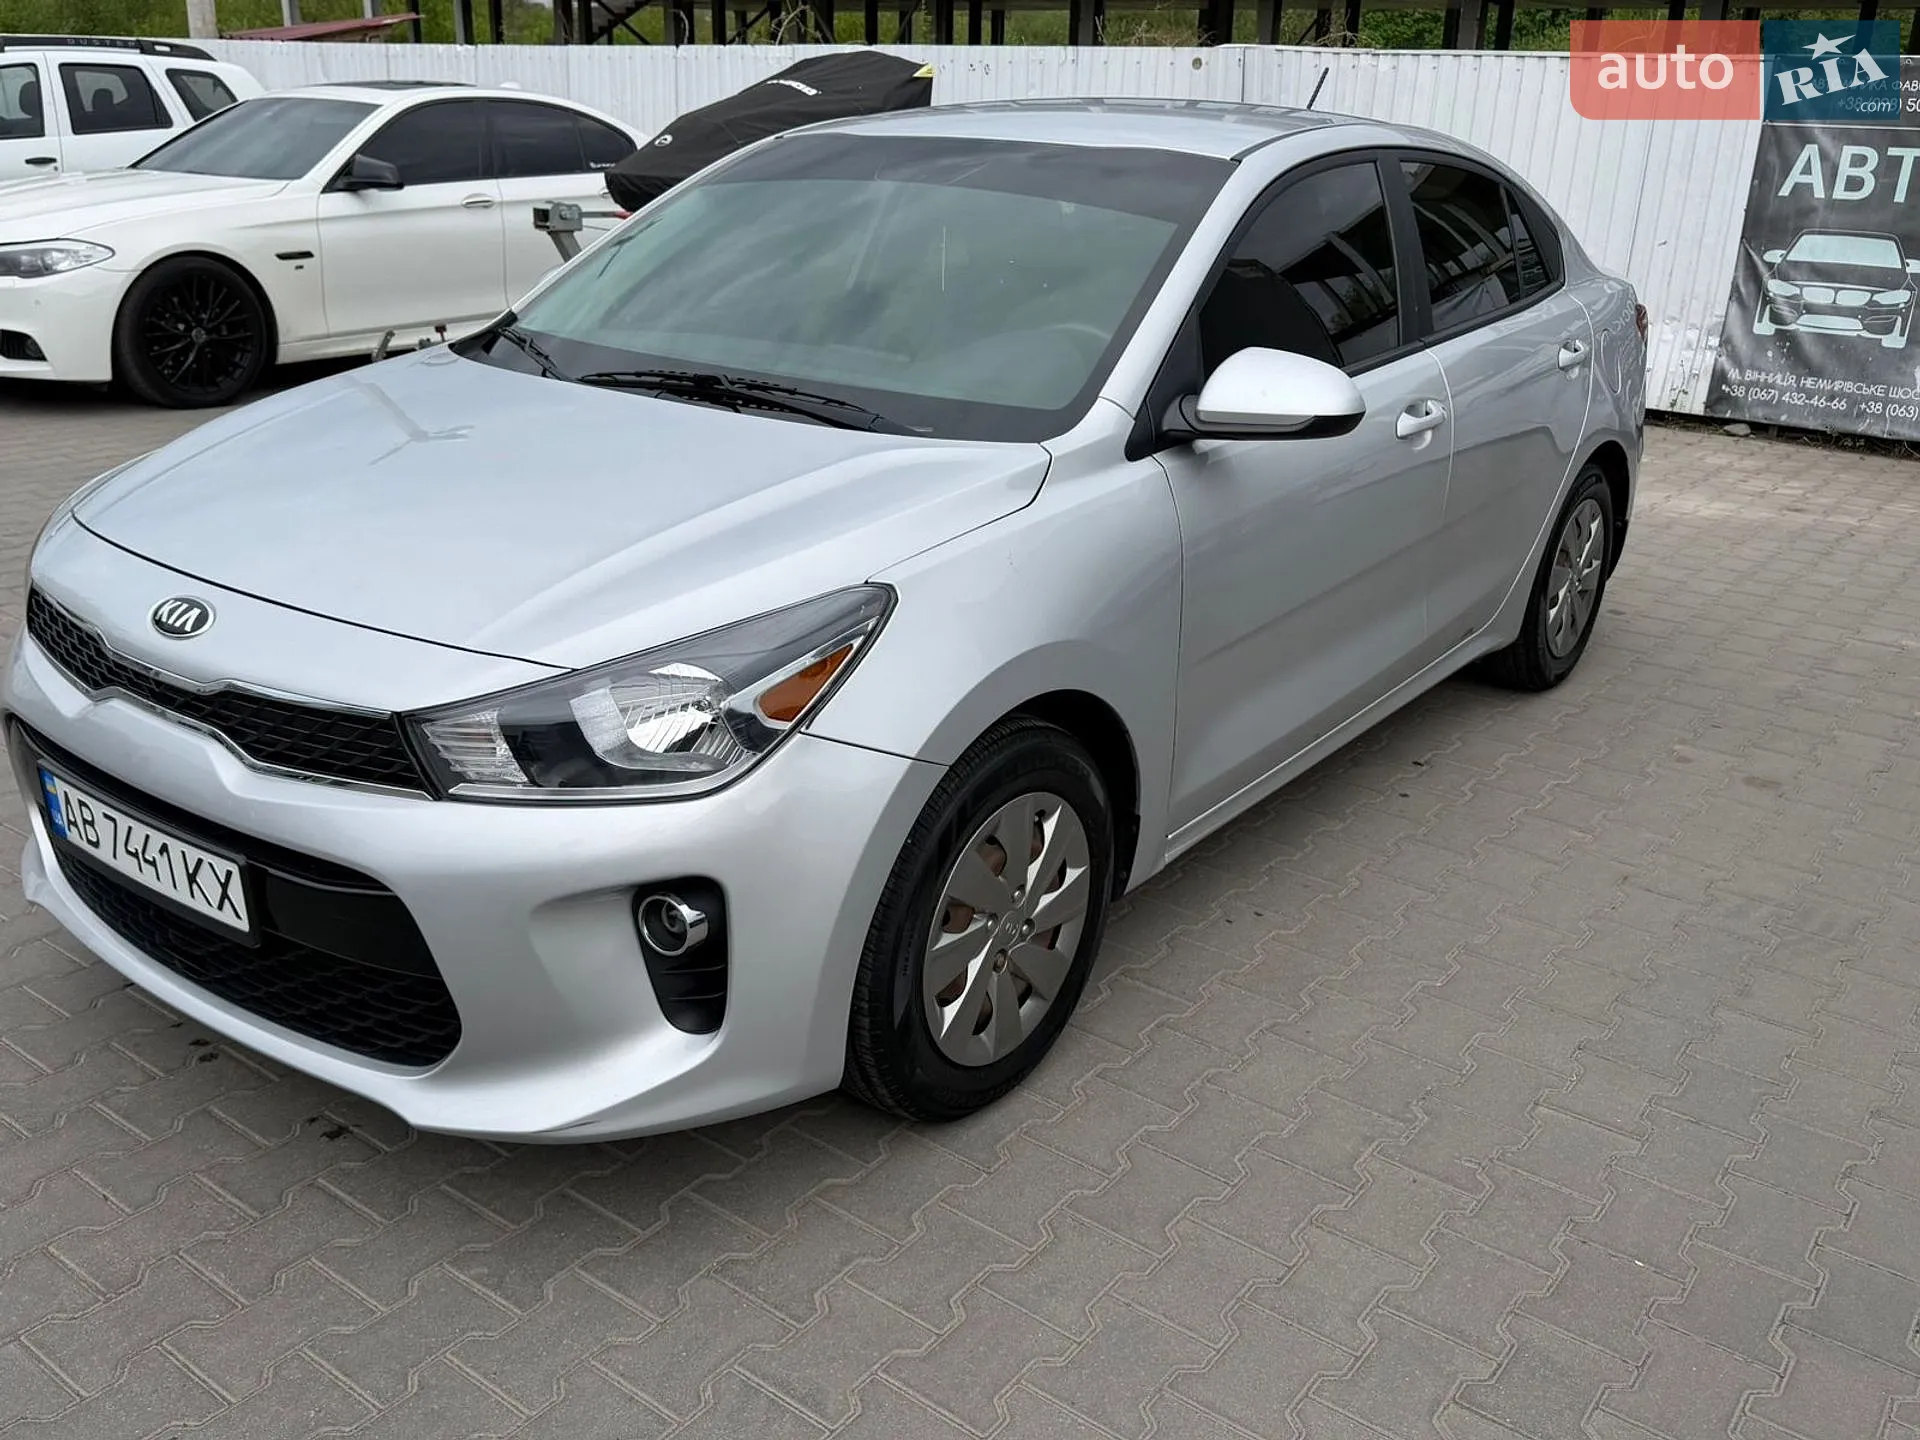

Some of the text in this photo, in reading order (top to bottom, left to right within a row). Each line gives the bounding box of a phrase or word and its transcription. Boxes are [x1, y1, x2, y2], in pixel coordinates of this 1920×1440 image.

[1891, 79, 1920, 92] ФАВ
[1777, 143, 1920, 204] АВТ
[1723, 384, 1919, 422] +38 (067) 432-46-66 +38 (063)
[154, 599, 202, 632] KIA
